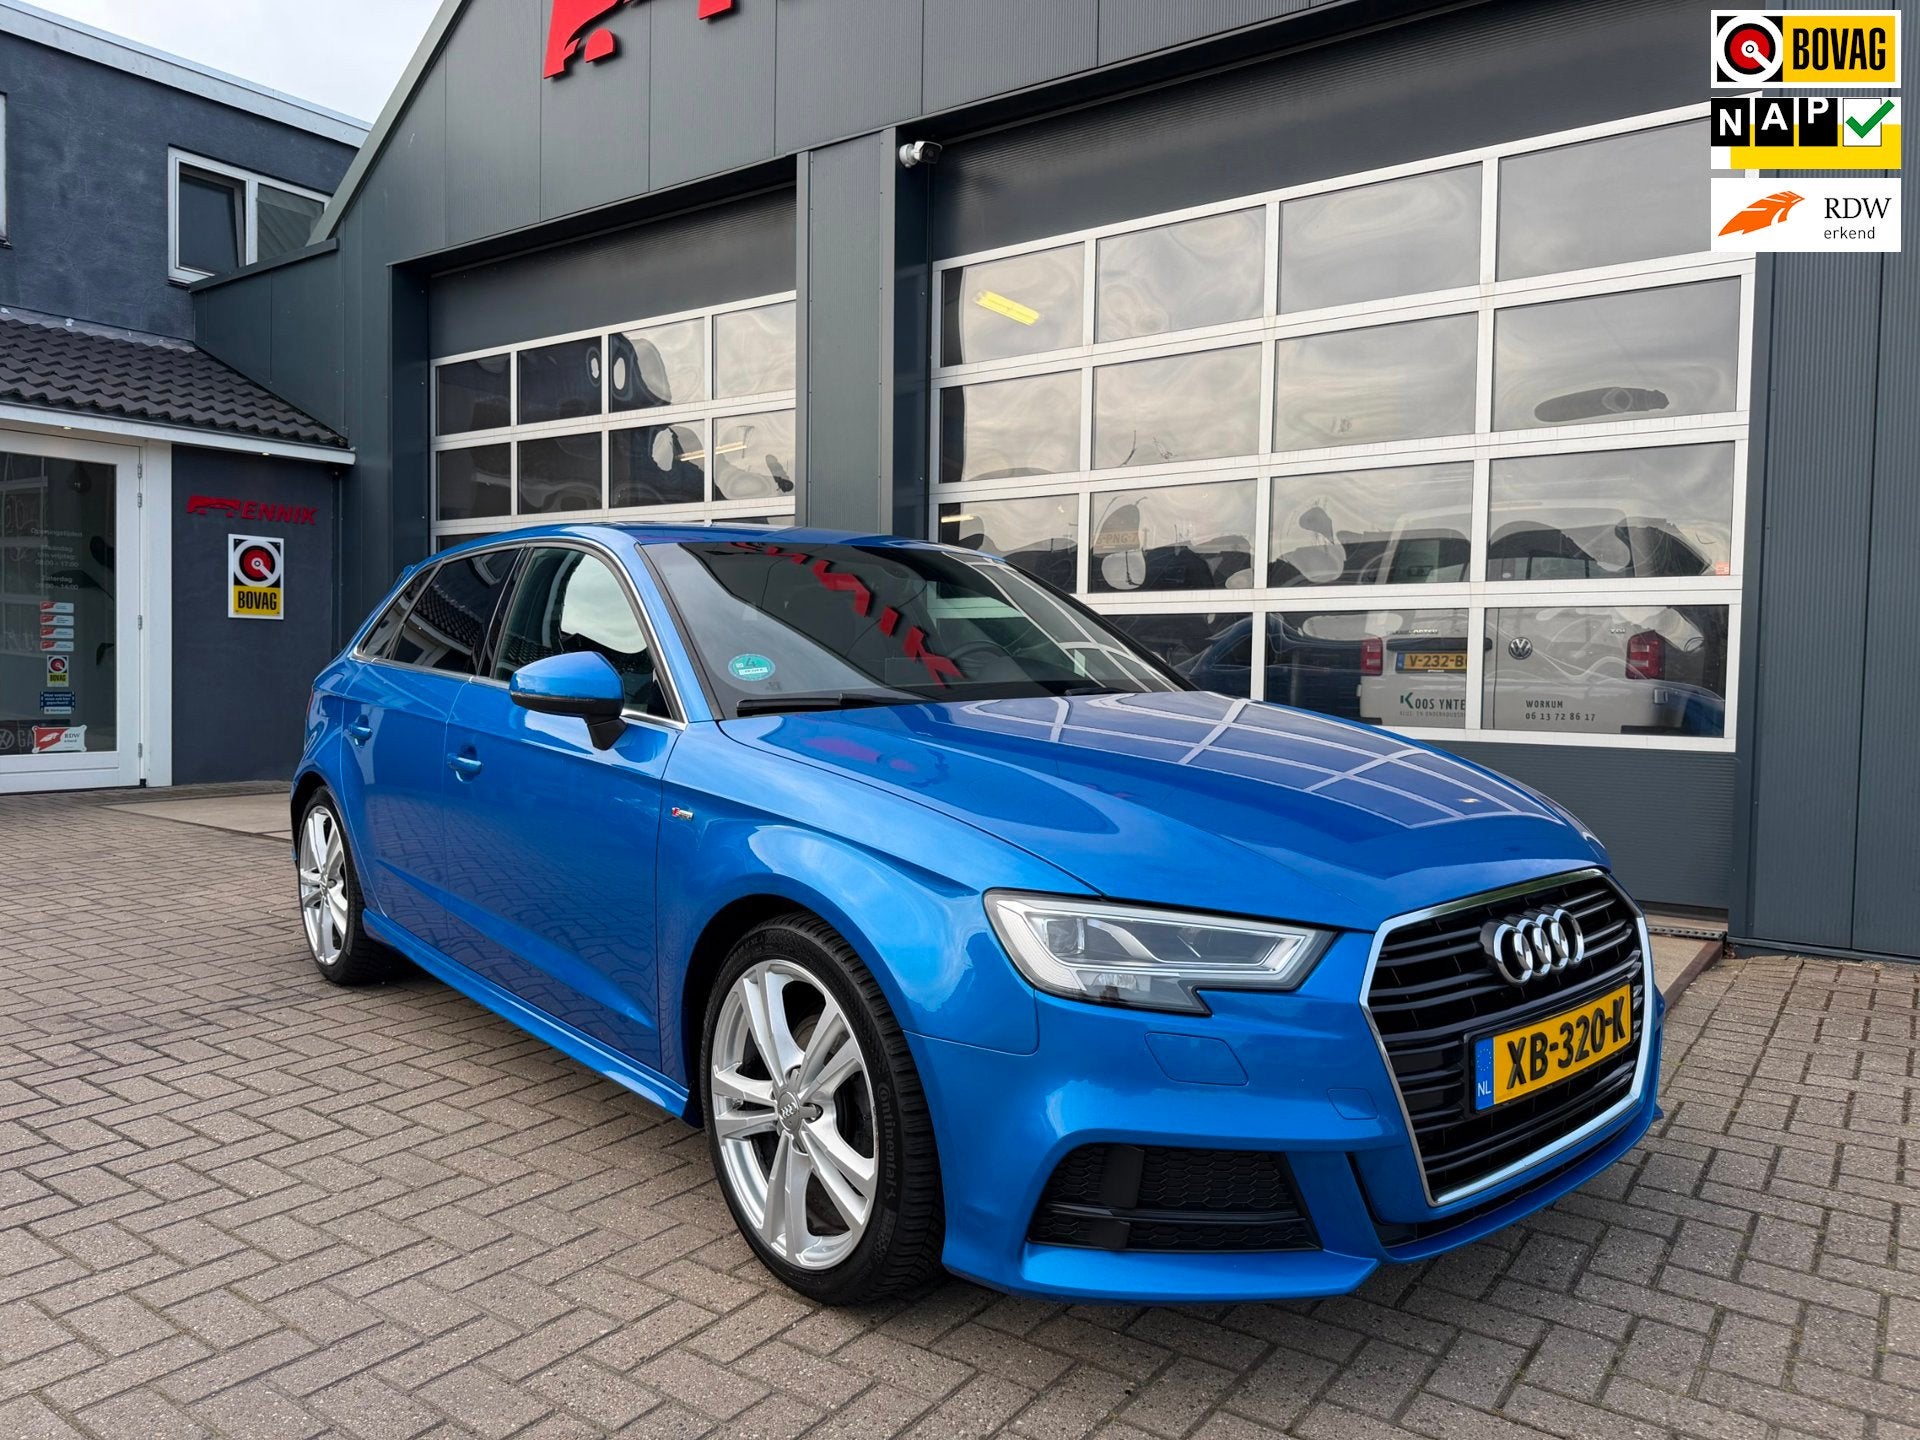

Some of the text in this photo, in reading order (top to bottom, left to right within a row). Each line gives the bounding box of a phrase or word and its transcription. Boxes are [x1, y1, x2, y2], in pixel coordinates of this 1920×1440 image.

[238, 590, 277, 611] BOVAG
[1409, 654, 1467, 668] V-232-B
[1400, 692, 1435, 709] KOOS
[1526, 700, 1563, 709] WORKUM
[1525, 712, 1595, 722] 06 13 72 86 17
[1506, 995, 1627, 1090] XB-320-K
[1477, 1080, 1492, 1097] NL
[877, 1081, 897, 1186] Continental
